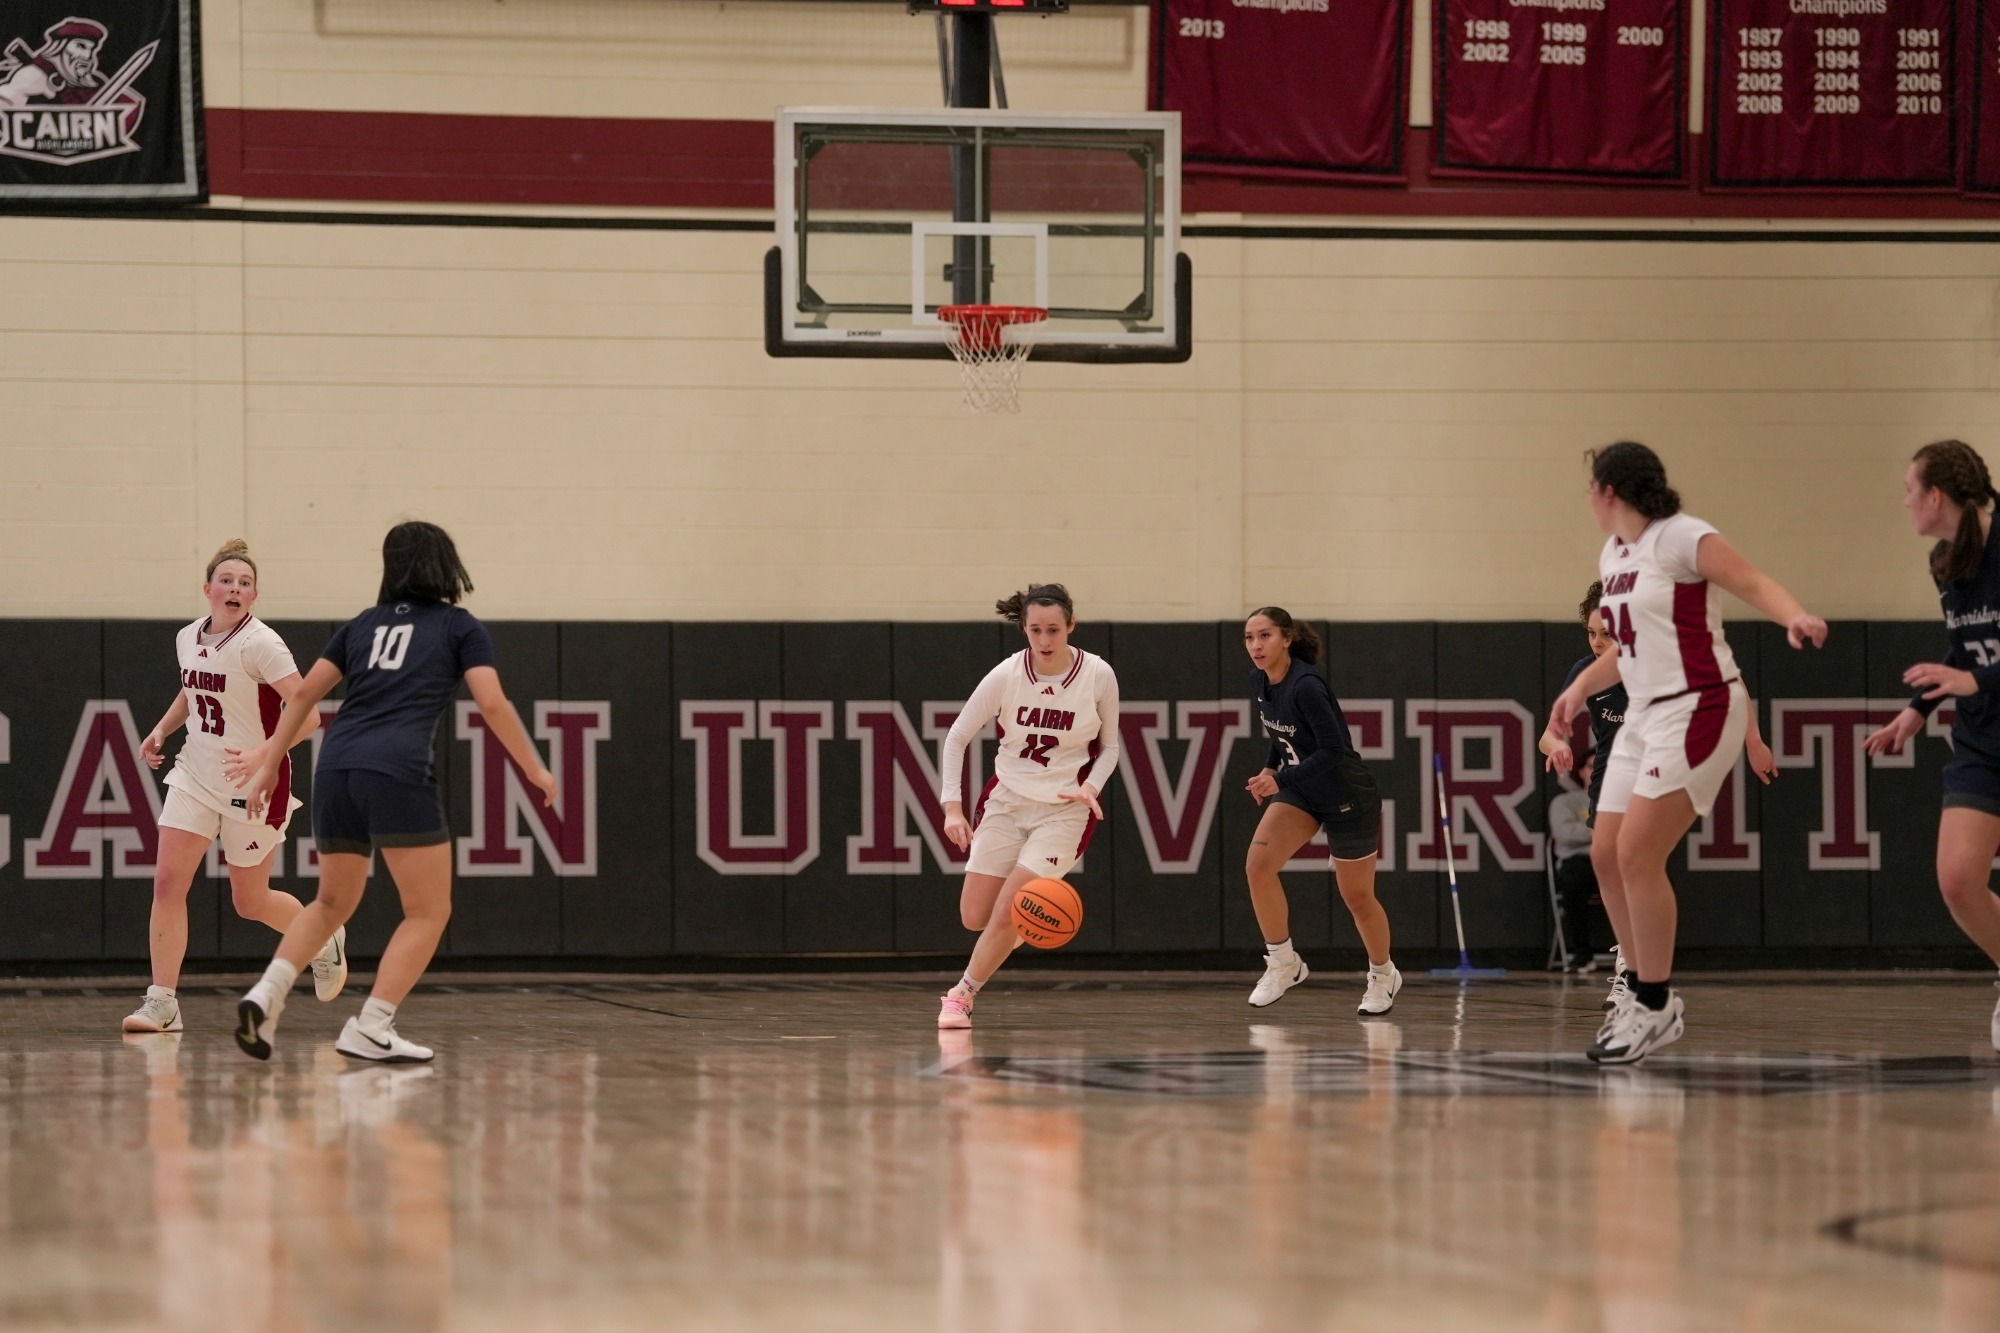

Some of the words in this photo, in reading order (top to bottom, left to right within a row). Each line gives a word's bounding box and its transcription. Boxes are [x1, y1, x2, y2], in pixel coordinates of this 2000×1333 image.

[1789, 0, 1888, 17] Champions
[1179, 17, 1225, 39] 2013
[1464, 19, 1510, 40] 1998
[1541, 21, 1587, 42] 1999
[1617, 26, 1664, 46] 2000
[1738, 28, 1783, 47] 1987
[1814, 28, 1860, 47] 1990
[1897, 28, 1939, 47] 1991
[1462, 42, 1510, 62] 2002
[1540, 45, 1586, 65] 2005
[1738, 50, 1783, 69] 1993
[1816, 50, 1860, 69] 1994
[1896, 50, 1939, 69] 2001
[1737, 73, 1783, 92] 2002
[1814, 73, 1860, 92] 2004
[1896, 73, 1942, 92] 2006
[1737, 95, 1783, 114] 2008
[1814, 95, 1860, 114] 2009
[1896, 95, 1942, 114] 2010
[12, 111, 117, 150] CAIRN
[368, 623, 414, 670] 10
[182, 668, 226, 693] CAIRN
[195, 694, 225, 737] 13
[1016, 706, 1076, 731] CAIRN
[1019, 734, 1060, 767] 12
[1277, 736, 1300, 766] 3
[1020, 896, 1061, 928] Wilson
